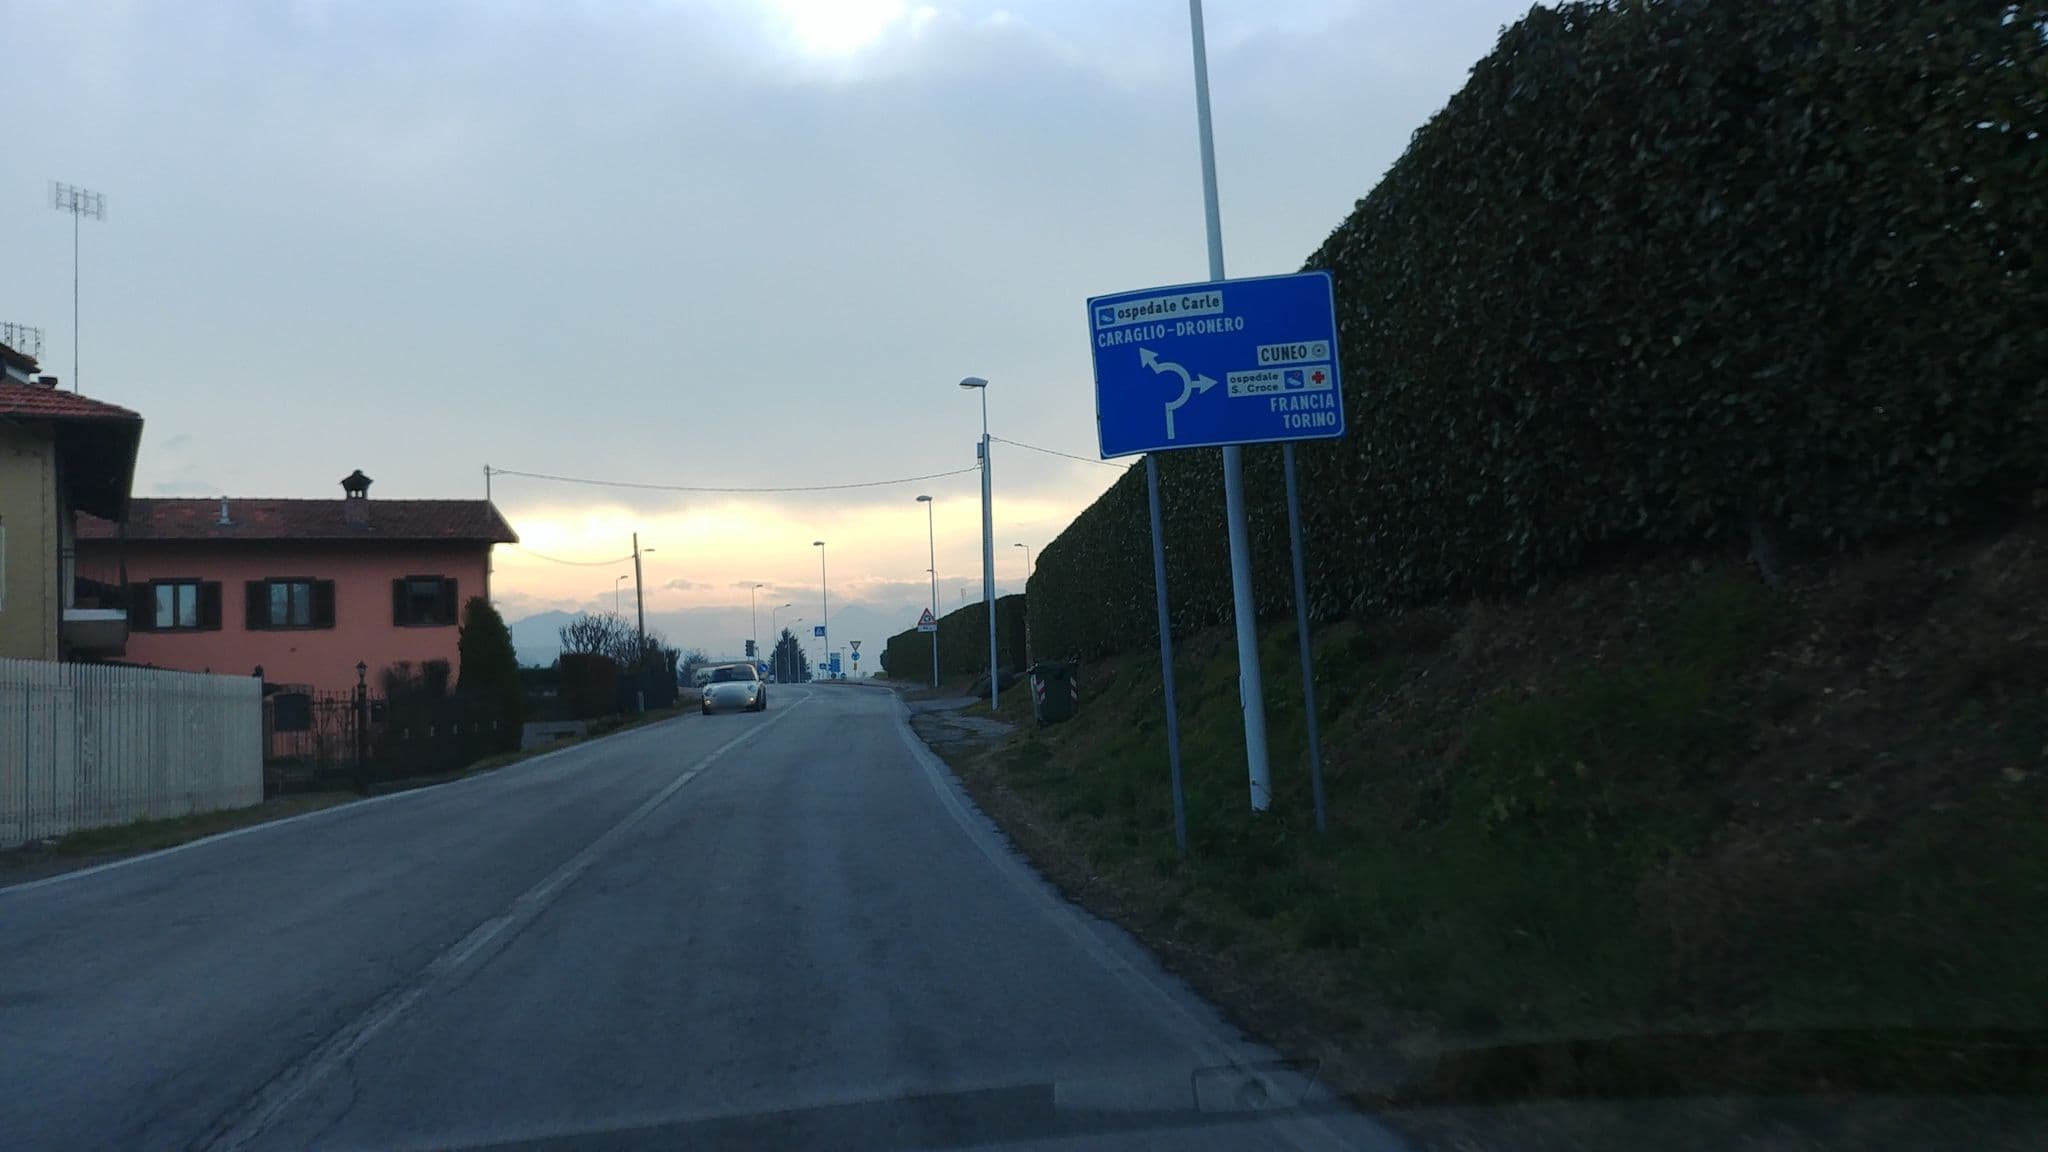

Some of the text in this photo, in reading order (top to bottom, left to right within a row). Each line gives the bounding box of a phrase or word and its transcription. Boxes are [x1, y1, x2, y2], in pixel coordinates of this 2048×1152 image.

[1118, 295, 1220, 320] ospedale Carle
[1098, 316, 1244, 348] CARAGLIO-DRONERO
[1261, 345, 1307, 362] CUNEO
[1230, 372, 1279, 385] ospedale
[1231, 384, 1279, 394] S. Croce
[1270, 393, 1335, 412] FRANCIA
[1283, 412, 1336, 429] TORINO
